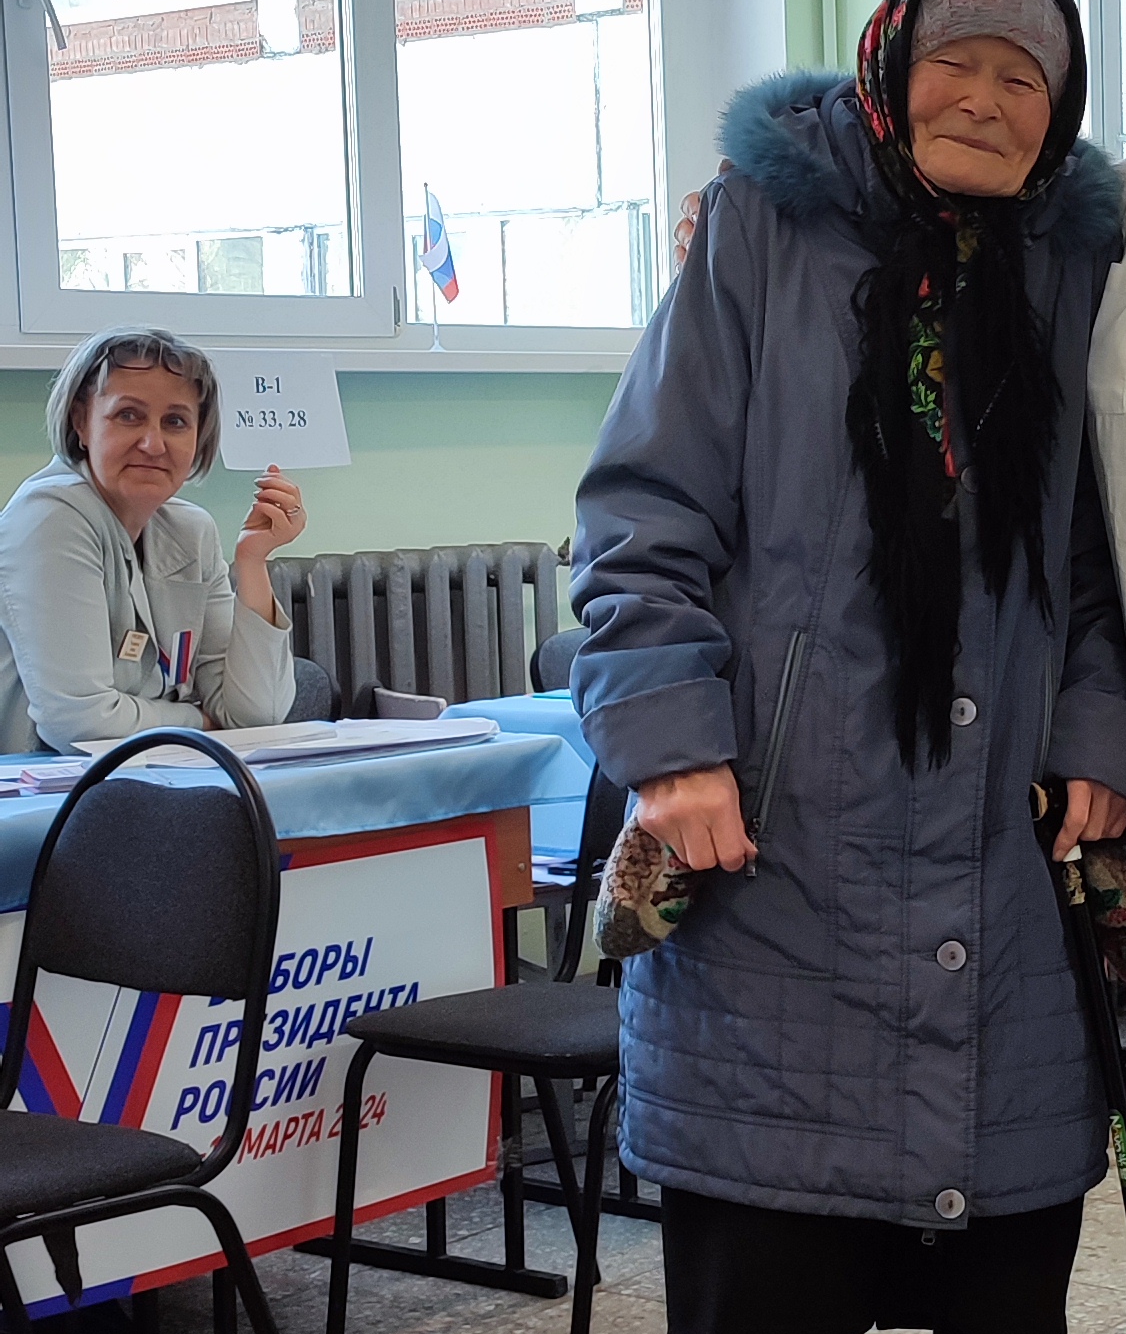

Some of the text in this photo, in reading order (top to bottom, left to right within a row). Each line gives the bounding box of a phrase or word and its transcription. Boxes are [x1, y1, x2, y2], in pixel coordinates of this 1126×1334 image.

[254, 376, 281, 394] В-1
[235, 410, 307, 430] № 33, 28
[237, 1108, 325, 1165] МАРТА
[326, 1092, 387, 1139] 224
